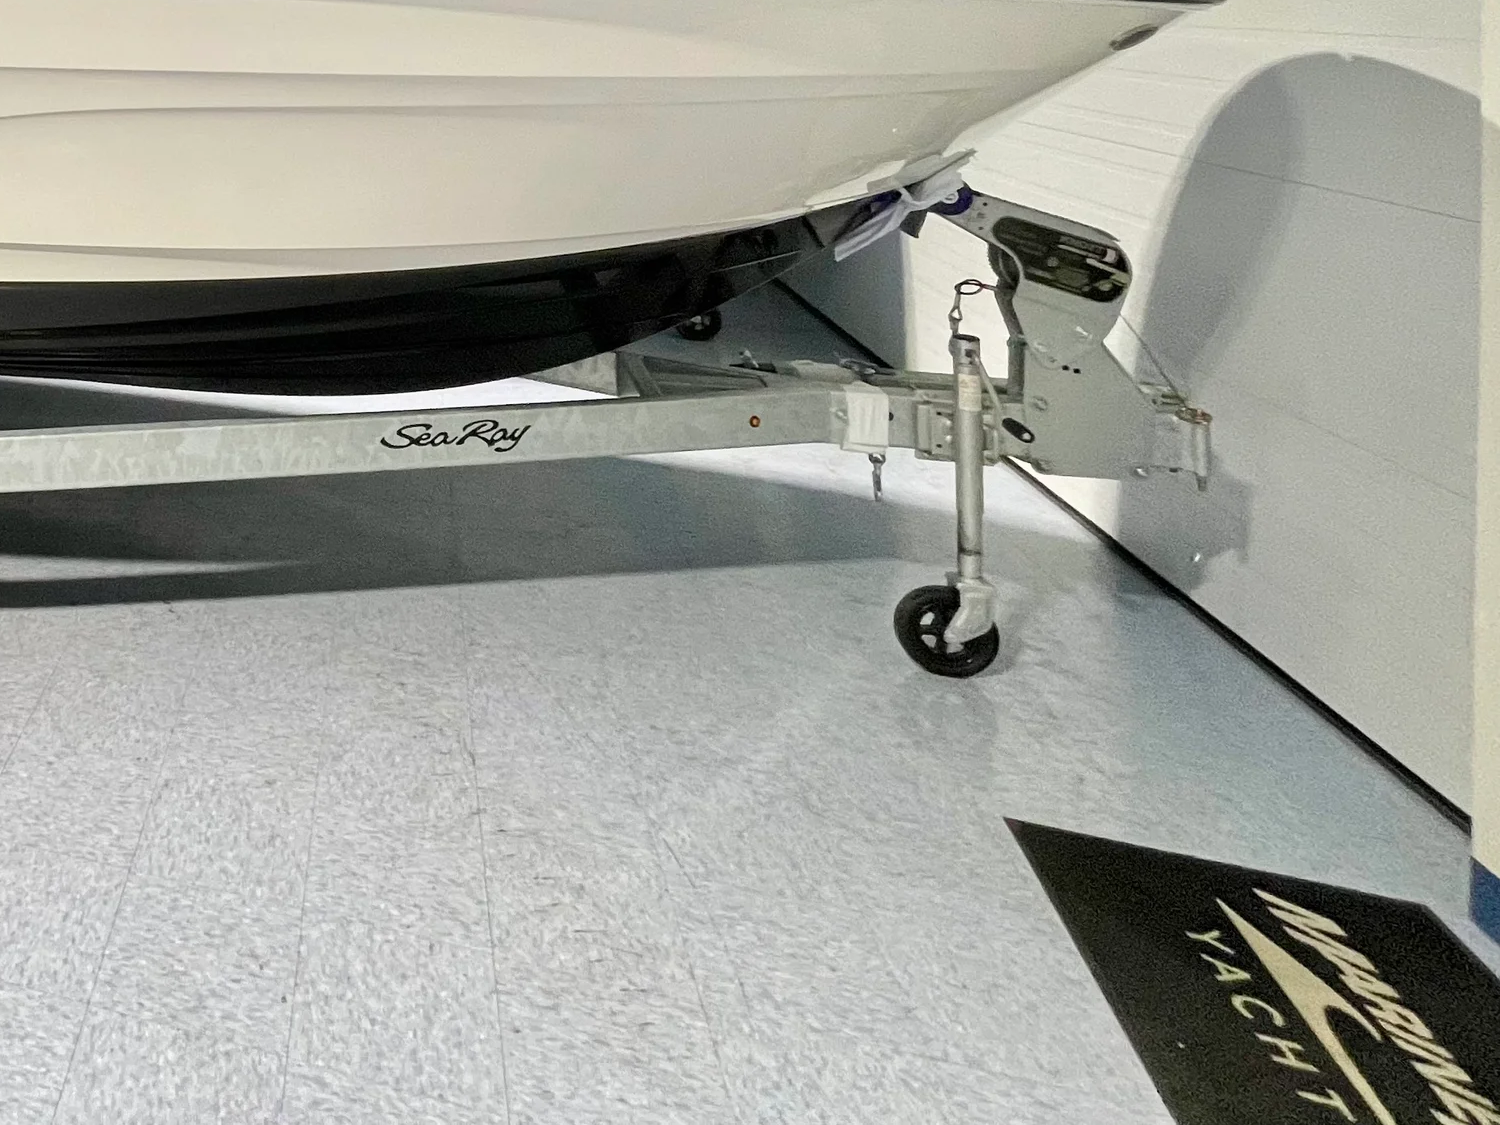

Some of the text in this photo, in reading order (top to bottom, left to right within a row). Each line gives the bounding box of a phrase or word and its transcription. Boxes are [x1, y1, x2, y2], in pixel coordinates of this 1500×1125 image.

[380, 419, 532, 453] Sea Ray
[1185, 930, 1358, 1123] YACHT
[1252, 887, 1500, 1125] MARINE
